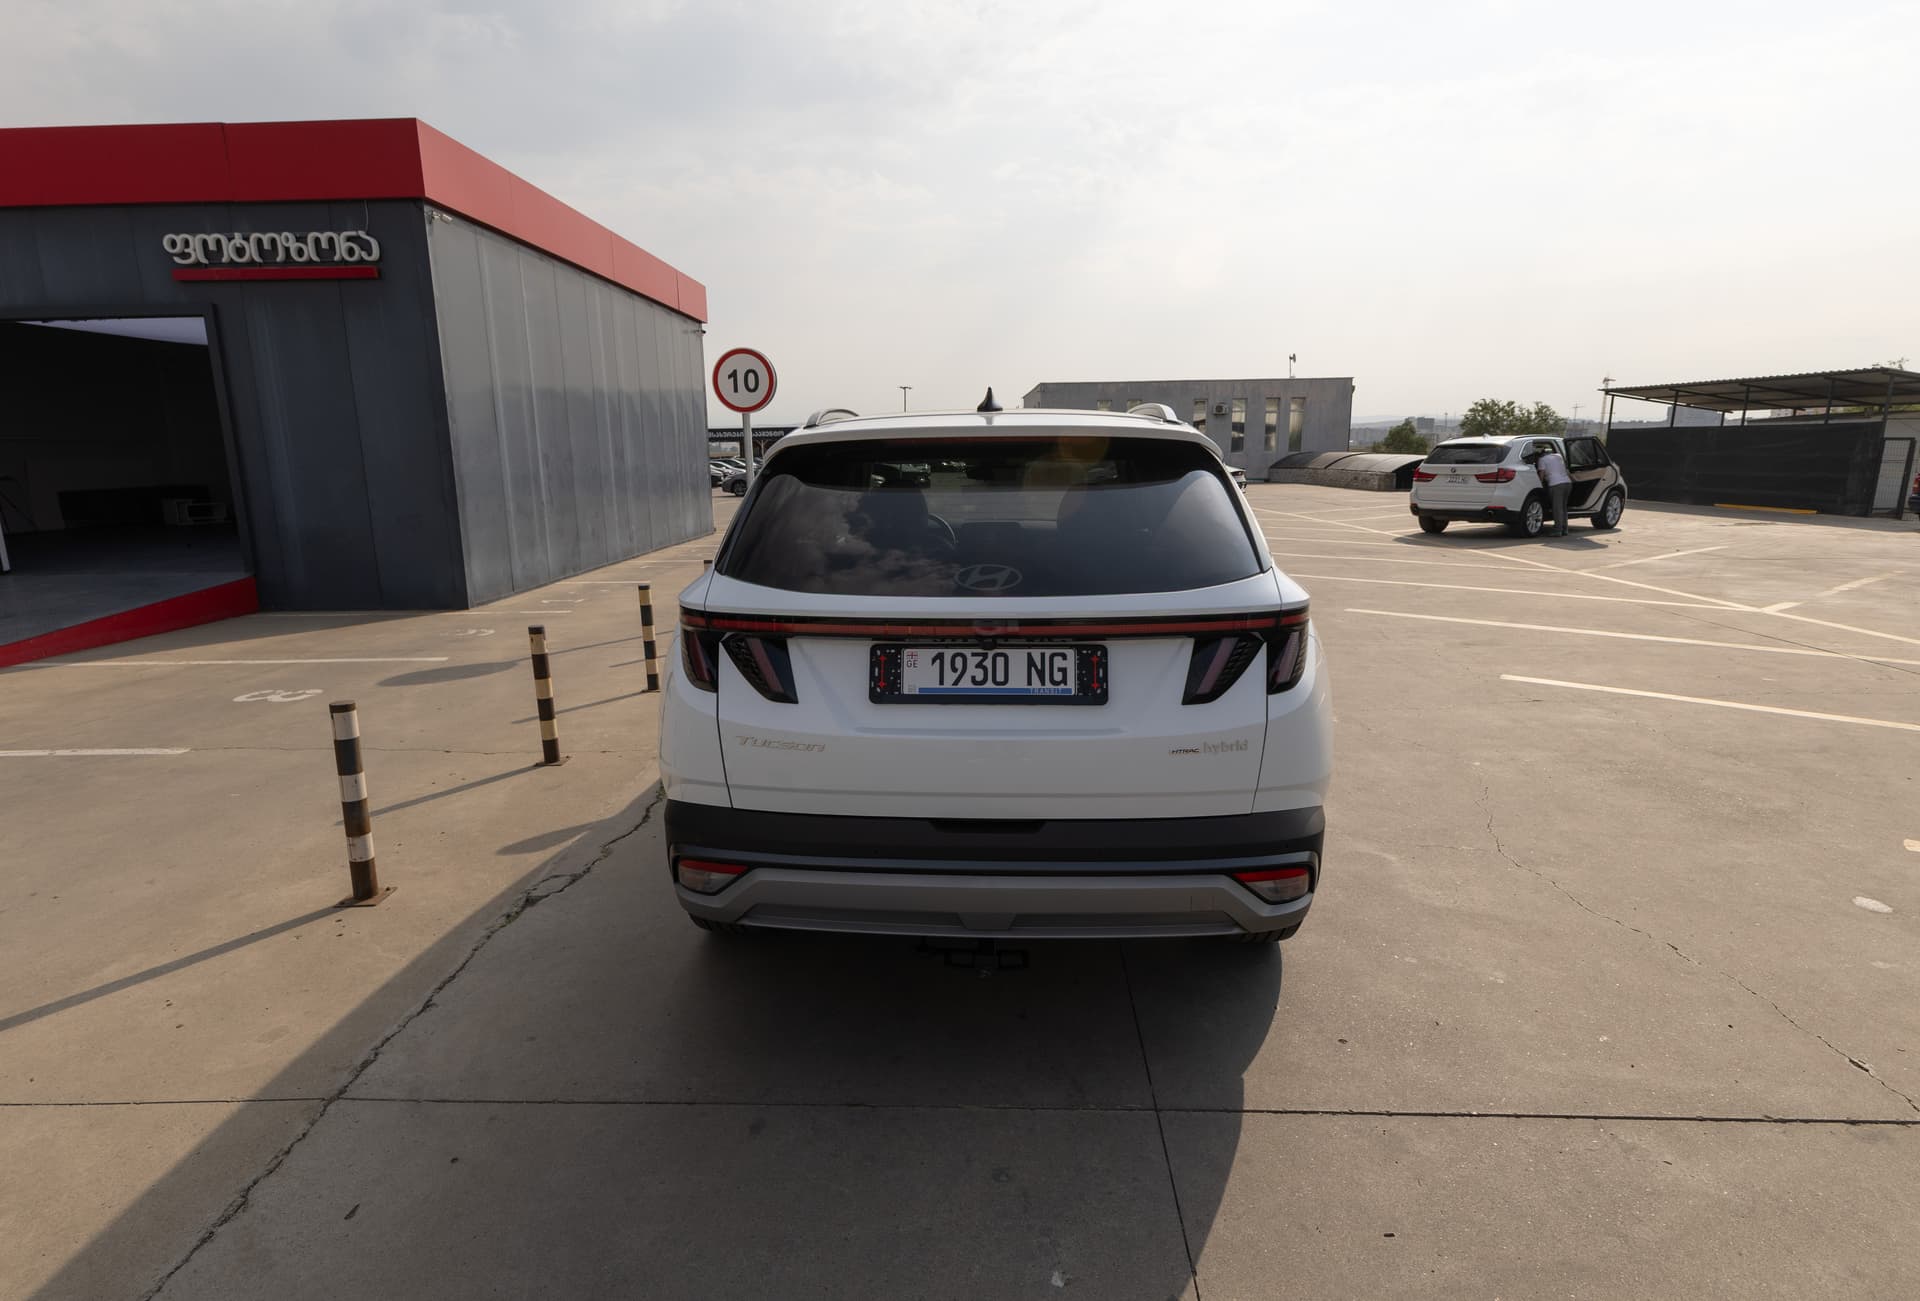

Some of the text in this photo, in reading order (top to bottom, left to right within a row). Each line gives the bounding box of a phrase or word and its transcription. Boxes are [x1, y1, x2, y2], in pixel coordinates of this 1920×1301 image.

[162, 230, 380, 265] ფოტოზონა
[727, 368, 760, 393] 10
[906, 659, 919, 668] GE
[930, 651, 1068, 687] 1930 NG
[1202, 739, 1248, 755] hybrid
